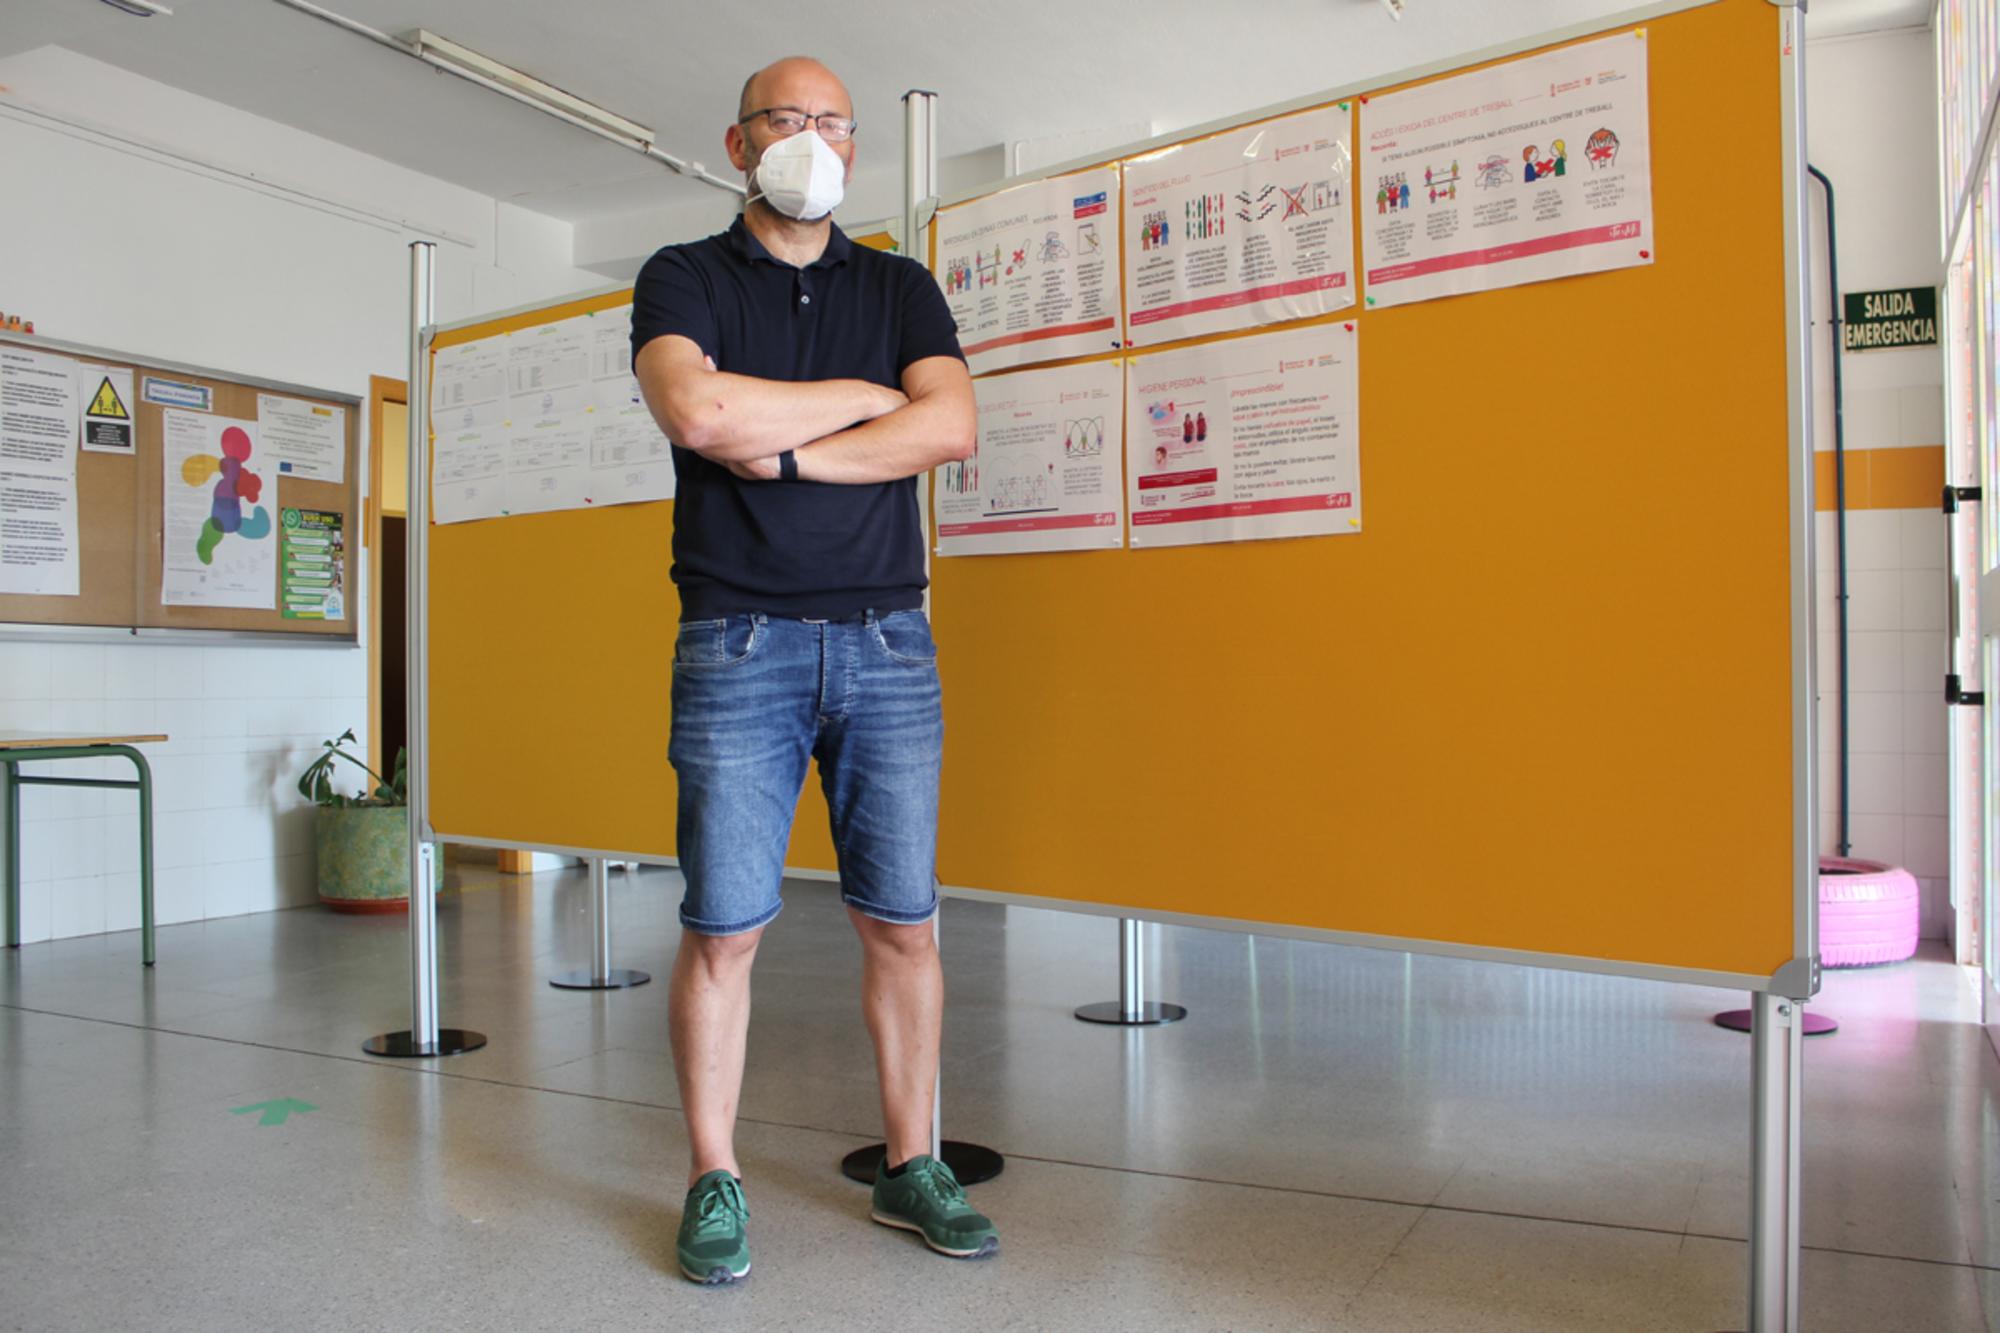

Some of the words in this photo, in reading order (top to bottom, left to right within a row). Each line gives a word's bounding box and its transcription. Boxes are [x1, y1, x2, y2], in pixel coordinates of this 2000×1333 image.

[1438, 110, 1467, 124] CENTRE
[1469, 107, 1479, 117] DE
[1481, 99, 1513, 112] TREBALL
[1585, 102, 1613, 115] TREBALL
[1864, 292, 1915, 318] SALIDA
[1846, 318, 1936, 347] EMERGENCIA
[1138, 383, 1169, 394] HIGIENE
[1169, 376, 1209, 390] PERSONAL
